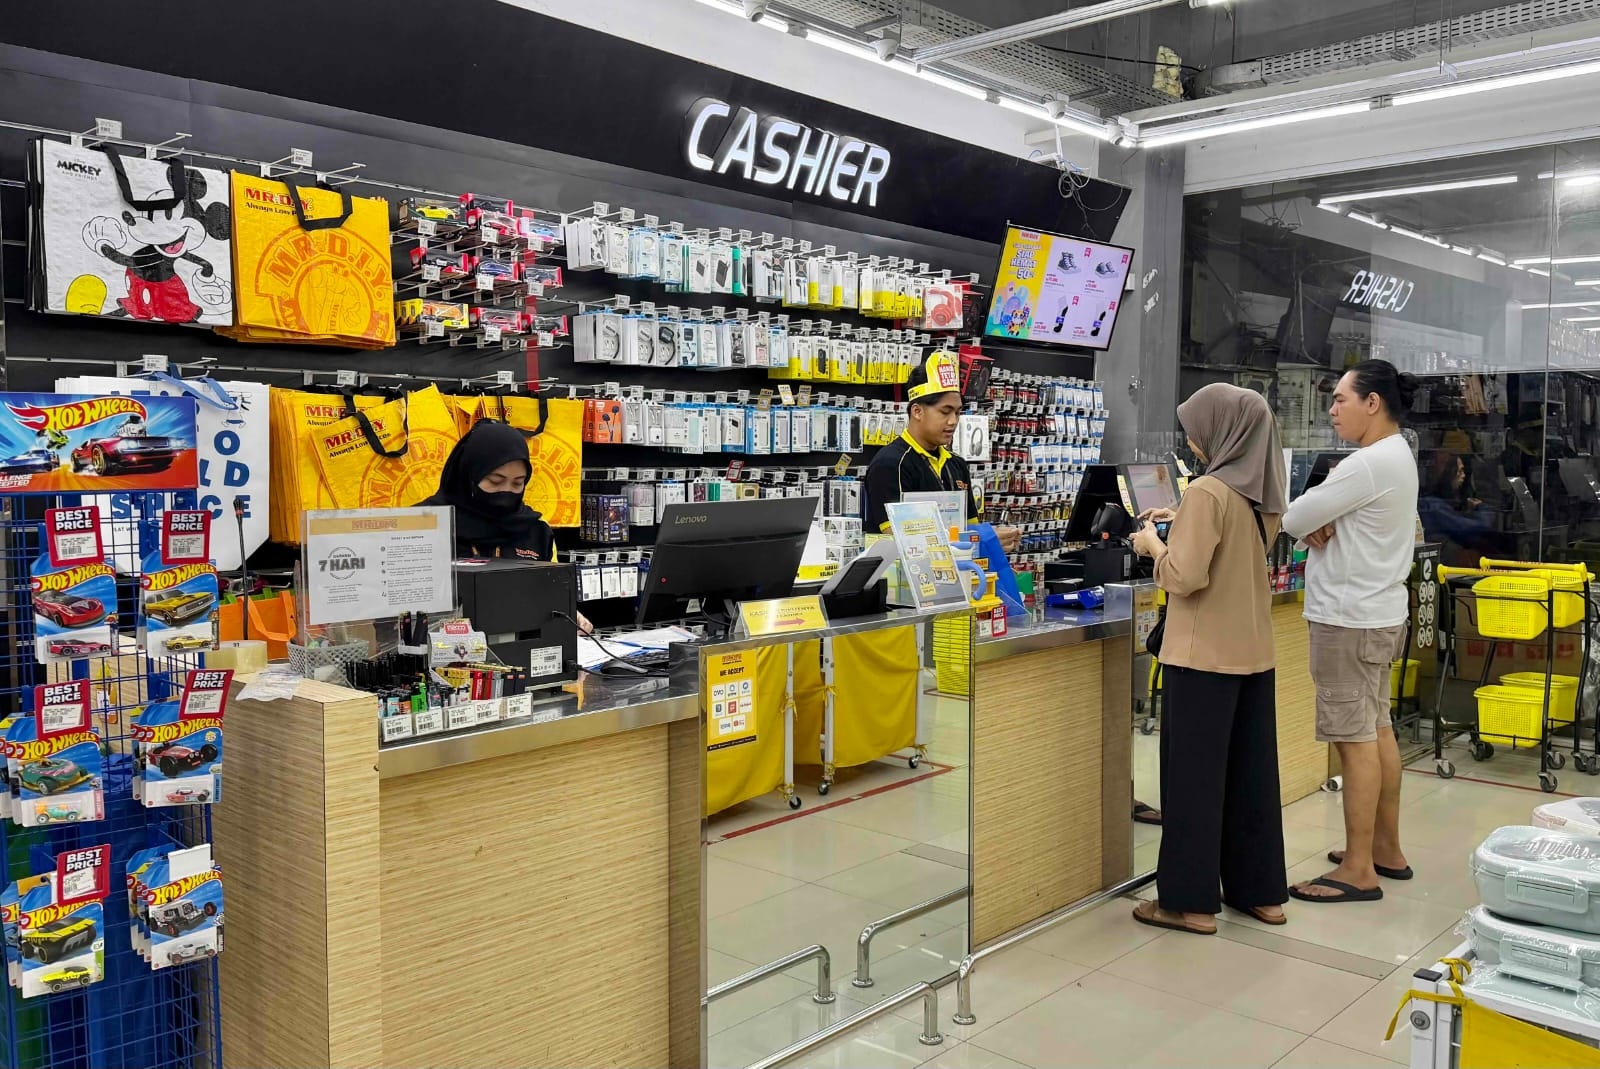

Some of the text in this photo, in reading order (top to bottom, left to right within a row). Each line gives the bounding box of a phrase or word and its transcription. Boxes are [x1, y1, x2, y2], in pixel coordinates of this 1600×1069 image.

[687, 101, 891, 207] CASHIER
[56, 159, 102, 176] MICKEY
[45, 406, 81, 431] HOT
[54, 509, 91, 522] BEST
[171, 513, 204, 523] BEST
[674, 515, 707, 525] Lenovo
[55, 519, 93, 531] PRICE
[170, 522, 203, 531] PRICE
[318, 557, 366, 572] 7 HARI
[38, 571, 69, 591] HOT
[151, 571, 179, 591] HOT
[195, 672, 228, 681] BEST
[44, 683, 81, 696] BEST
[192, 680, 225, 689] PRICE
[44, 693, 82, 706] PRICE
[154, 723, 181, 743] HOT
[22, 738, 53, 760] HOT
[66, 848, 103, 864] BEST
[66, 857, 103, 873] PRICE
[154, 882, 181, 906] HOT
